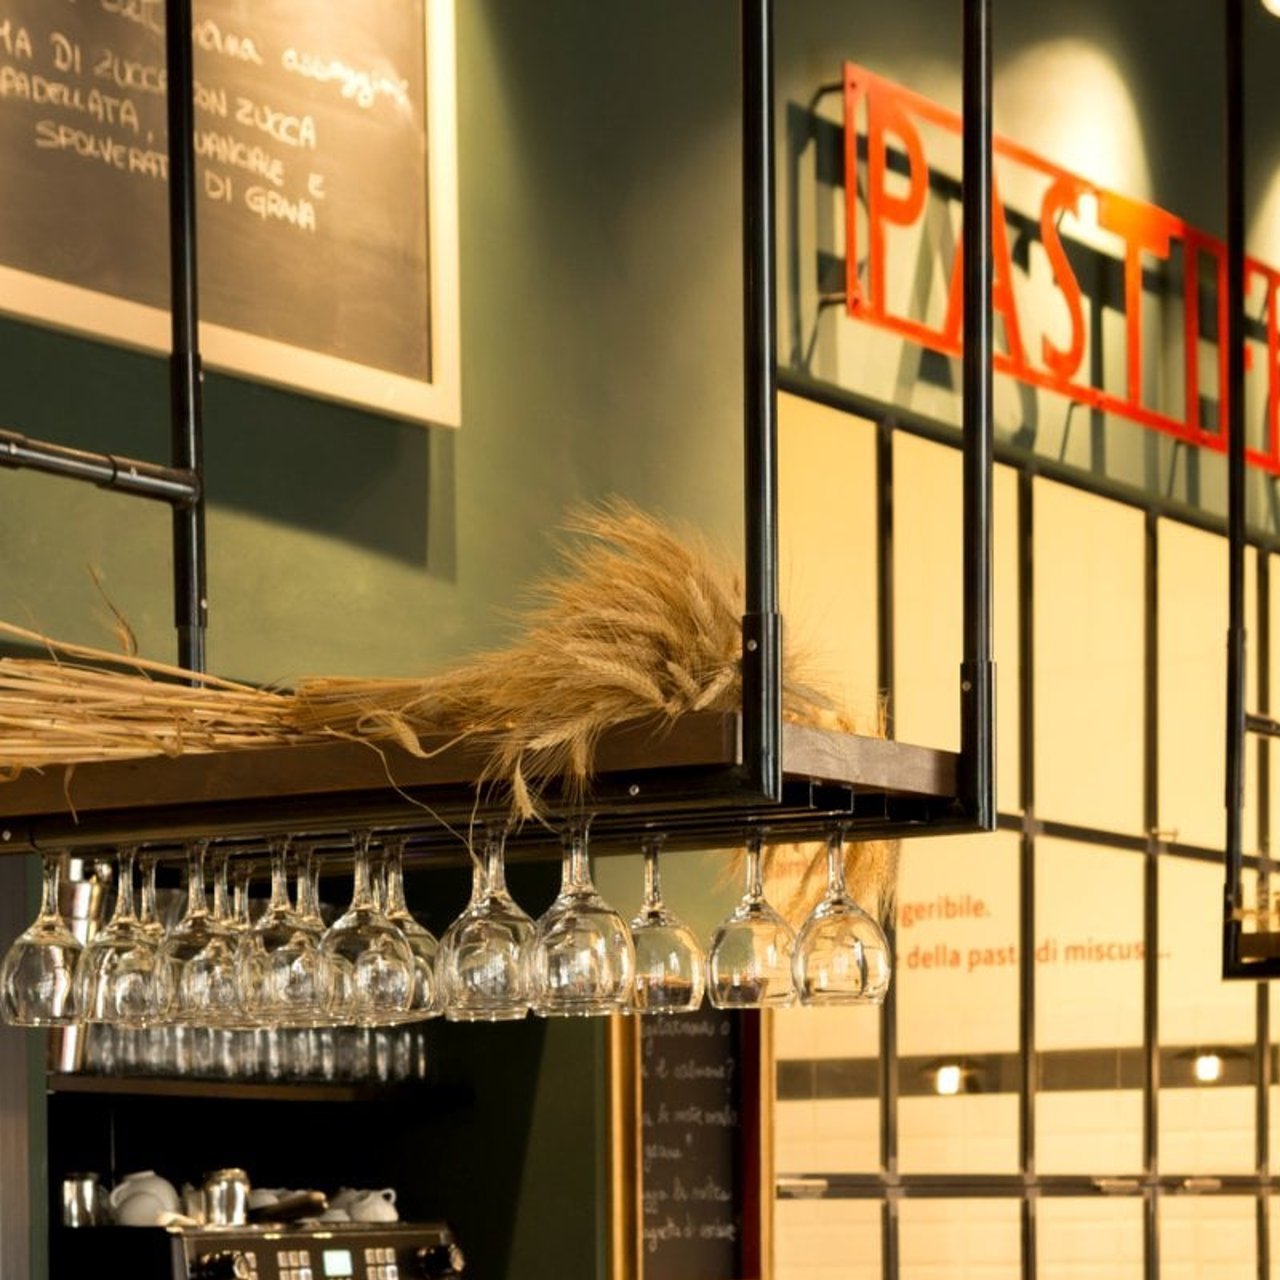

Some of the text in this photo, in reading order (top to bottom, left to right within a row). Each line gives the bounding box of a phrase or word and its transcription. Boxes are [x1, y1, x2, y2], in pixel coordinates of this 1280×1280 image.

[50, 32, 82, 74] DI
[193, 82, 228, 118] ON
[237, 97, 317, 149] ZUCCA
[35, 120, 317, 233] SPOLVERAT DI GRANA
[907, 945, 961, 969] della
[969, 942, 1020, 973] past
